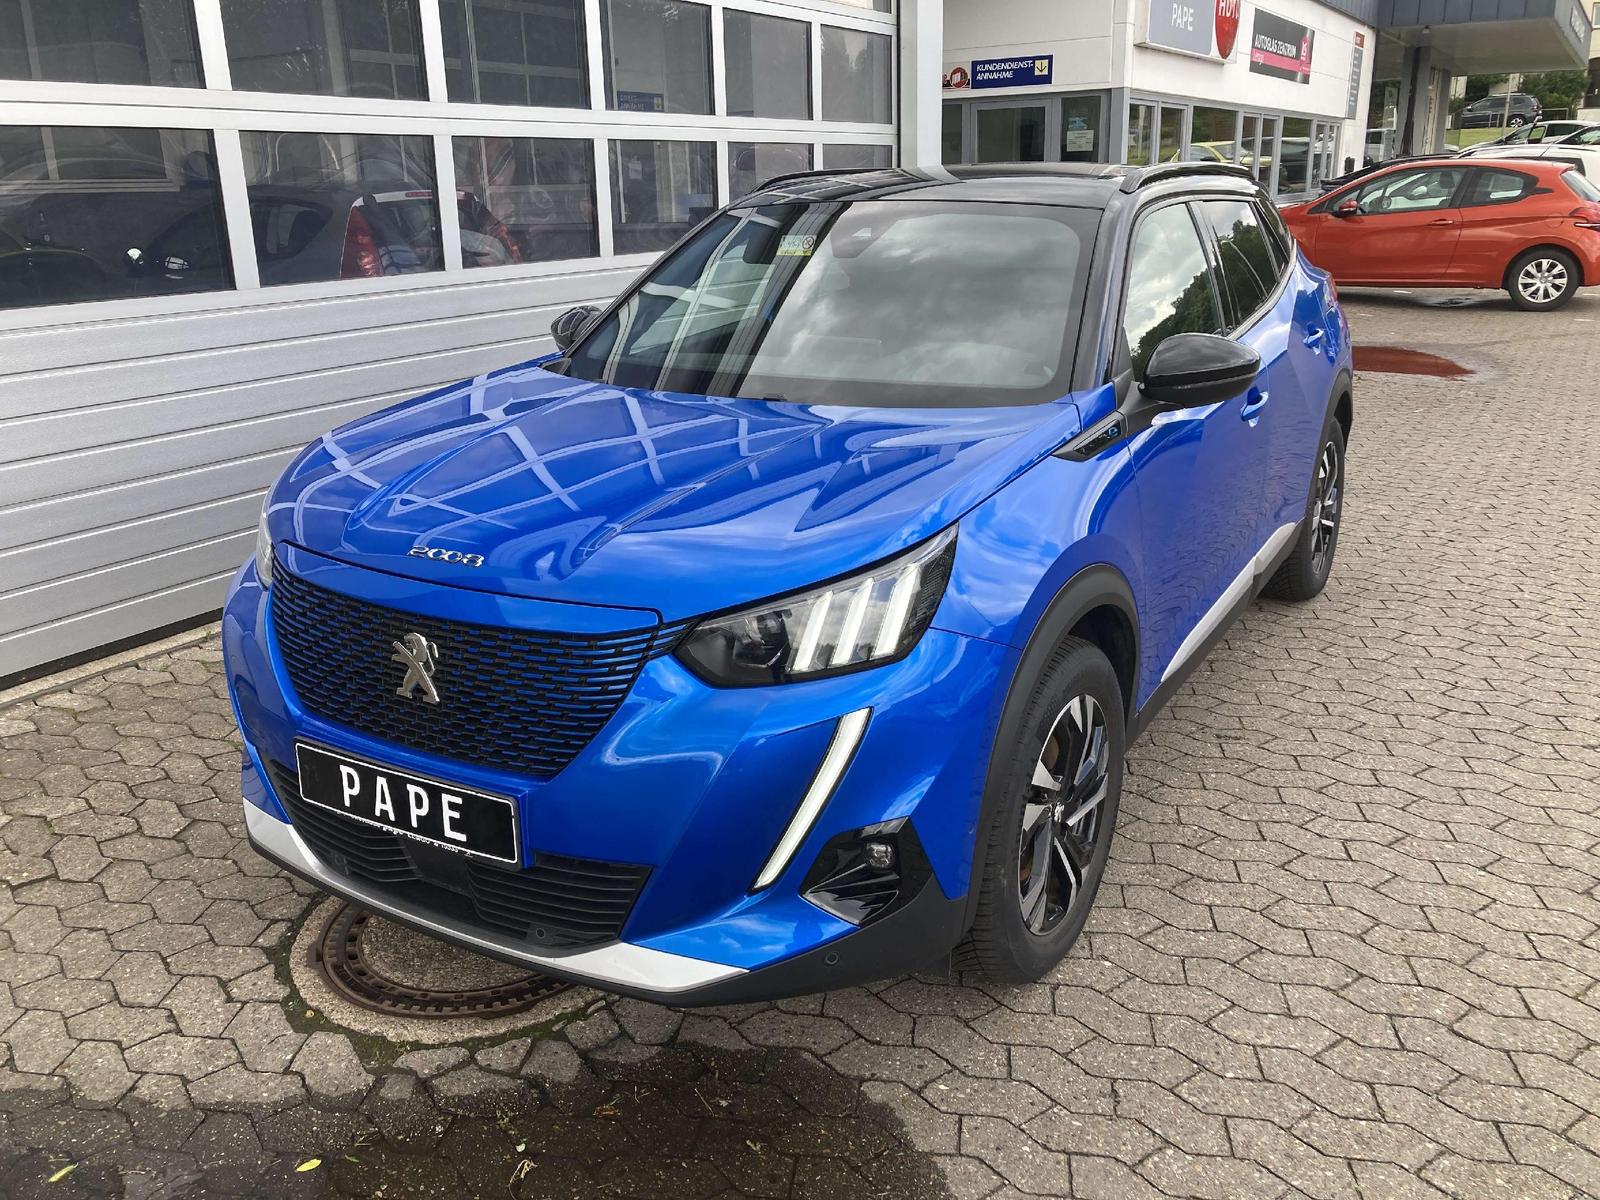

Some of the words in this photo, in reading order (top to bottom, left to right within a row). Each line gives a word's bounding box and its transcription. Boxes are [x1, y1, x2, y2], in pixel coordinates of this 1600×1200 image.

[1171, 3, 1194, 31] PAPE
[1255, 34, 1278, 53] AUTOGLAS
[1277, 41, 1297, 58] ZENTRUM
[976, 60, 1033, 71] KUNDENDIENST-
[976, 71, 1013, 80] ANNAHME
[406, 545, 485, 567] 2008
[339, 764, 467, 842] PAPE
